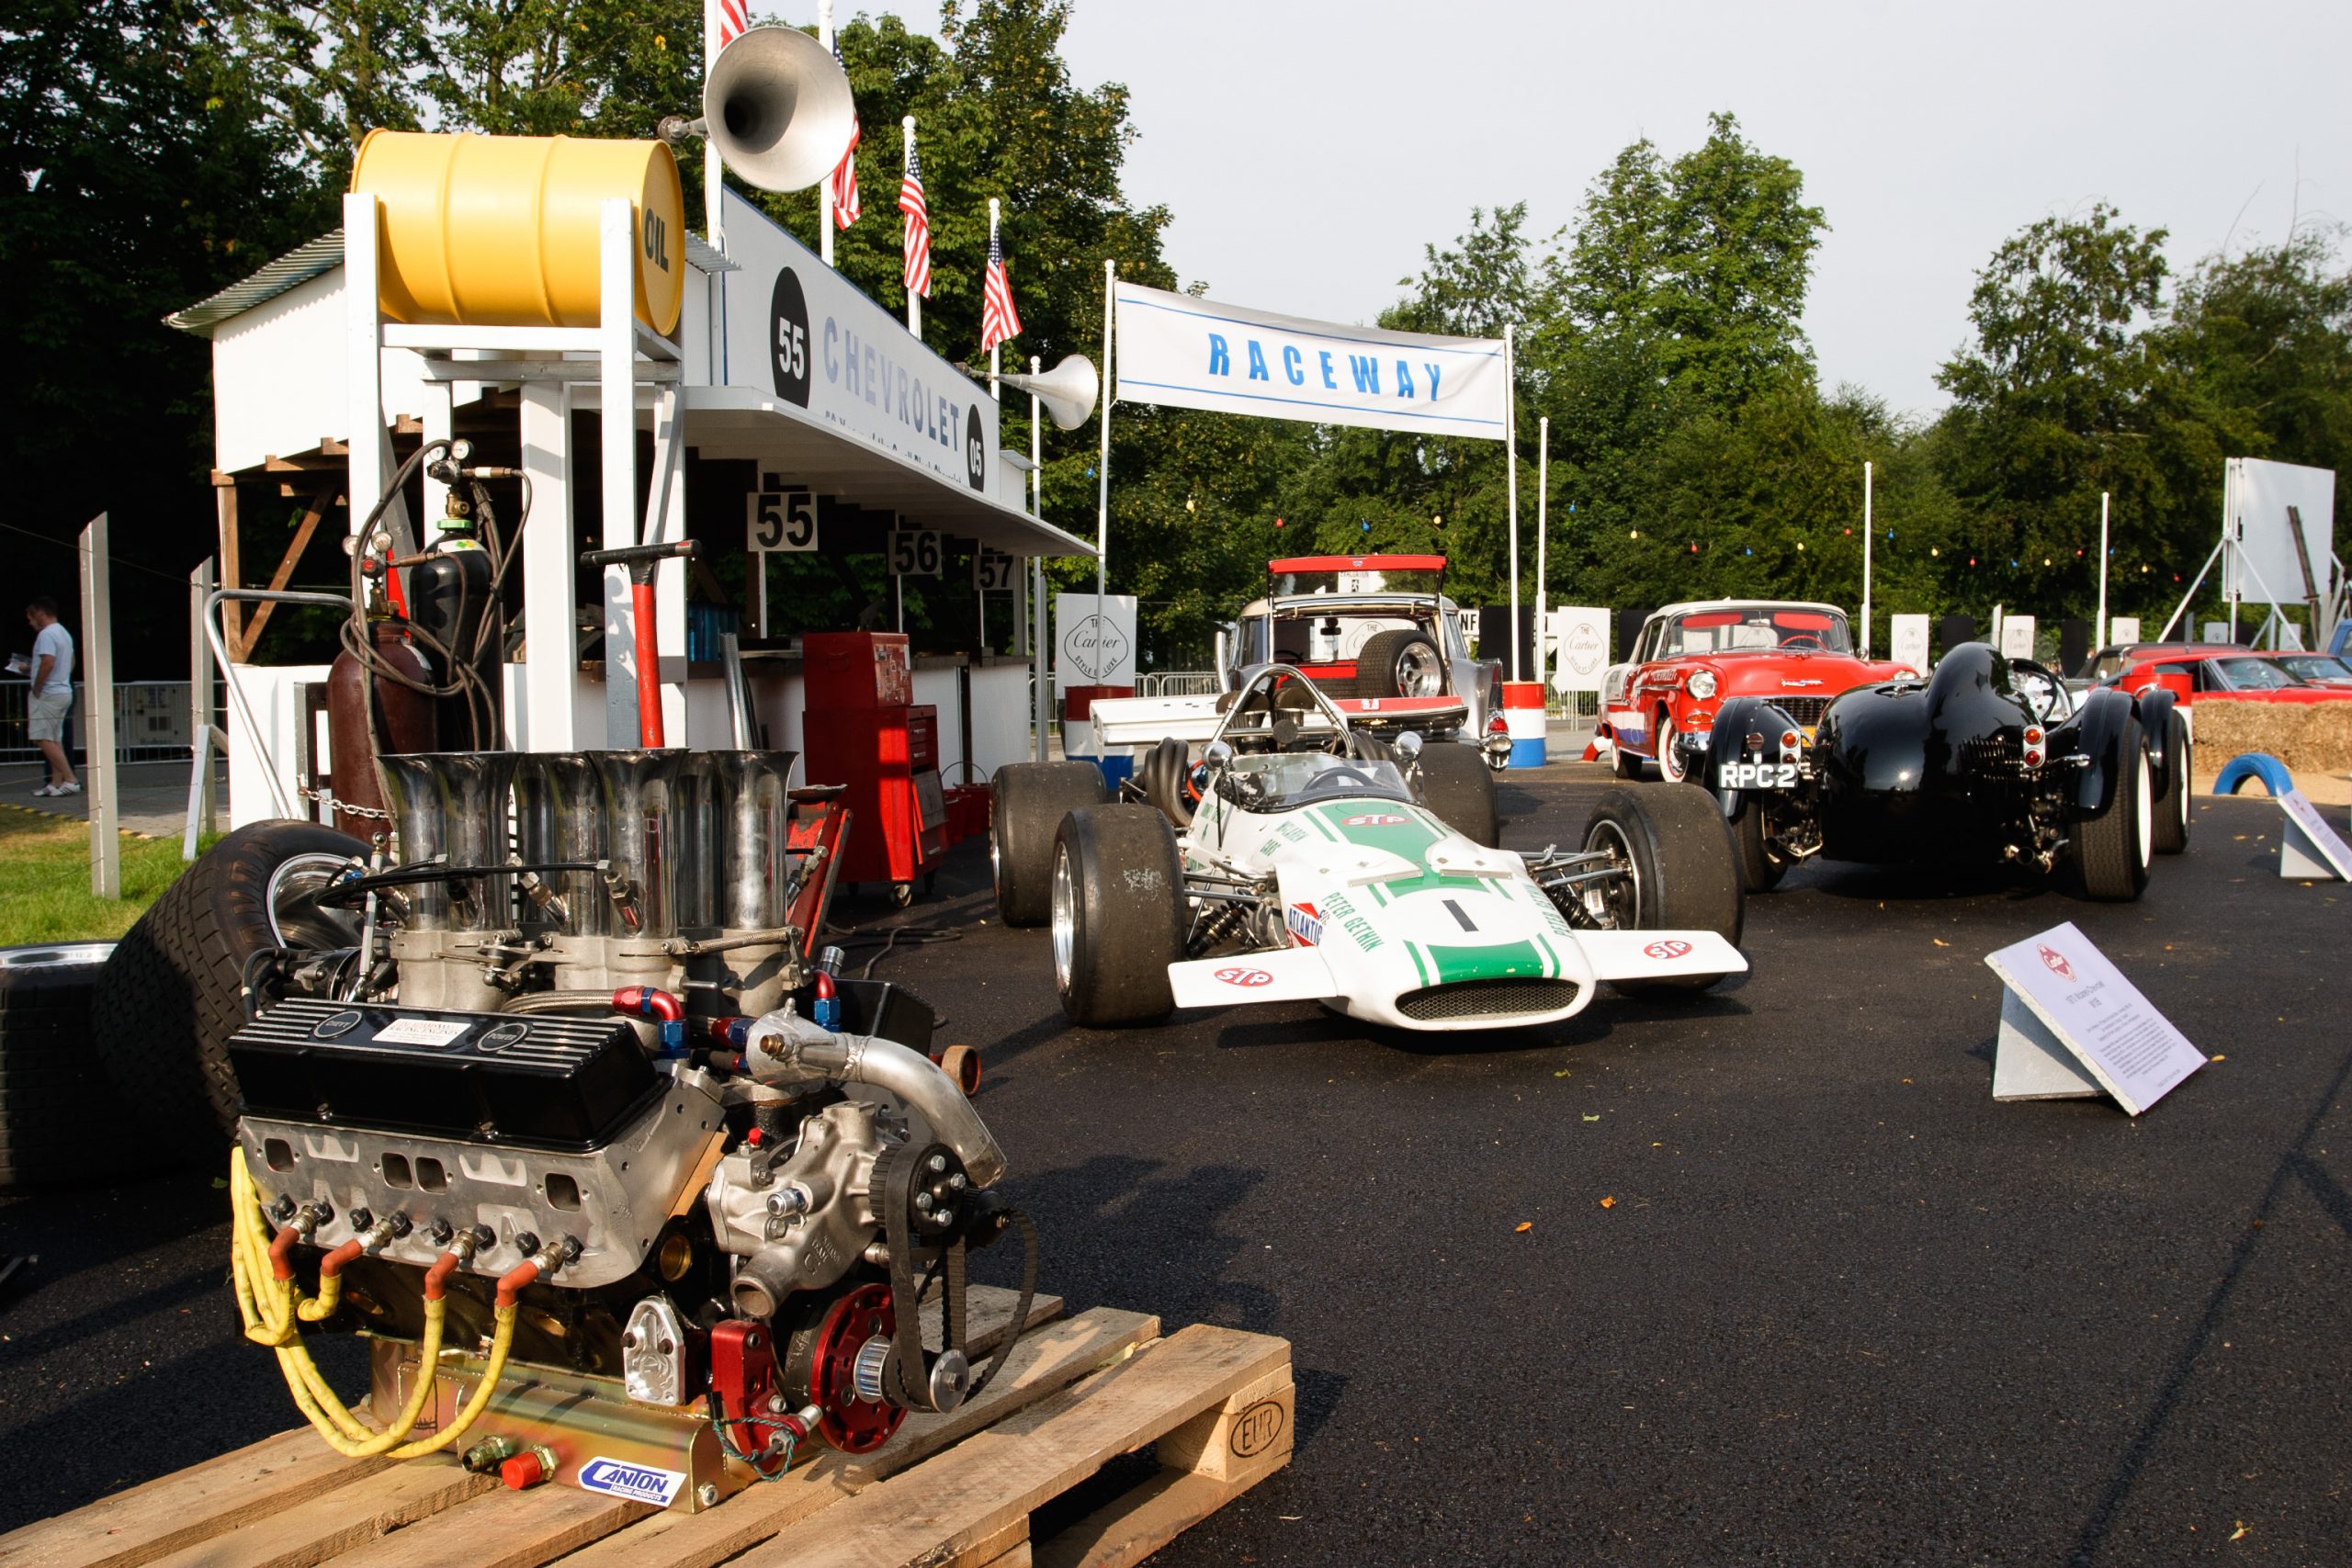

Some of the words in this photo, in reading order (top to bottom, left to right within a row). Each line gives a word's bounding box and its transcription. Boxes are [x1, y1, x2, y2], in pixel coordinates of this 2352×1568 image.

[645, 208, 669, 273] OIL
[778, 316, 805, 380] 55
[1208, 333, 1441, 401] RACEWAY
[823, 316, 959, 452] CHEVROLET
[970, 437, 982, 477] 05
[756, 493, 814, 547] 55
[895, 531, 938, 573] 56
[979, 556, 1013, 589] 57
[1073, 629, 1120, 649] Carier
[1348, 814, 1406, 826] STP
[1288, 907, 1324, 947] ATLANTIC
[1321, 891, 1356, 919] PETER
[1343, 917, 1385, 953] GETHIN
[1442, 899, 1479, 932] 1
[1648, 941, 1688, 959] STP
[1216, 968, 1271, 985] STP
[1242, 1408, 1272, 1451] EUR
[581, 1460, 669, 1494] CANTON
